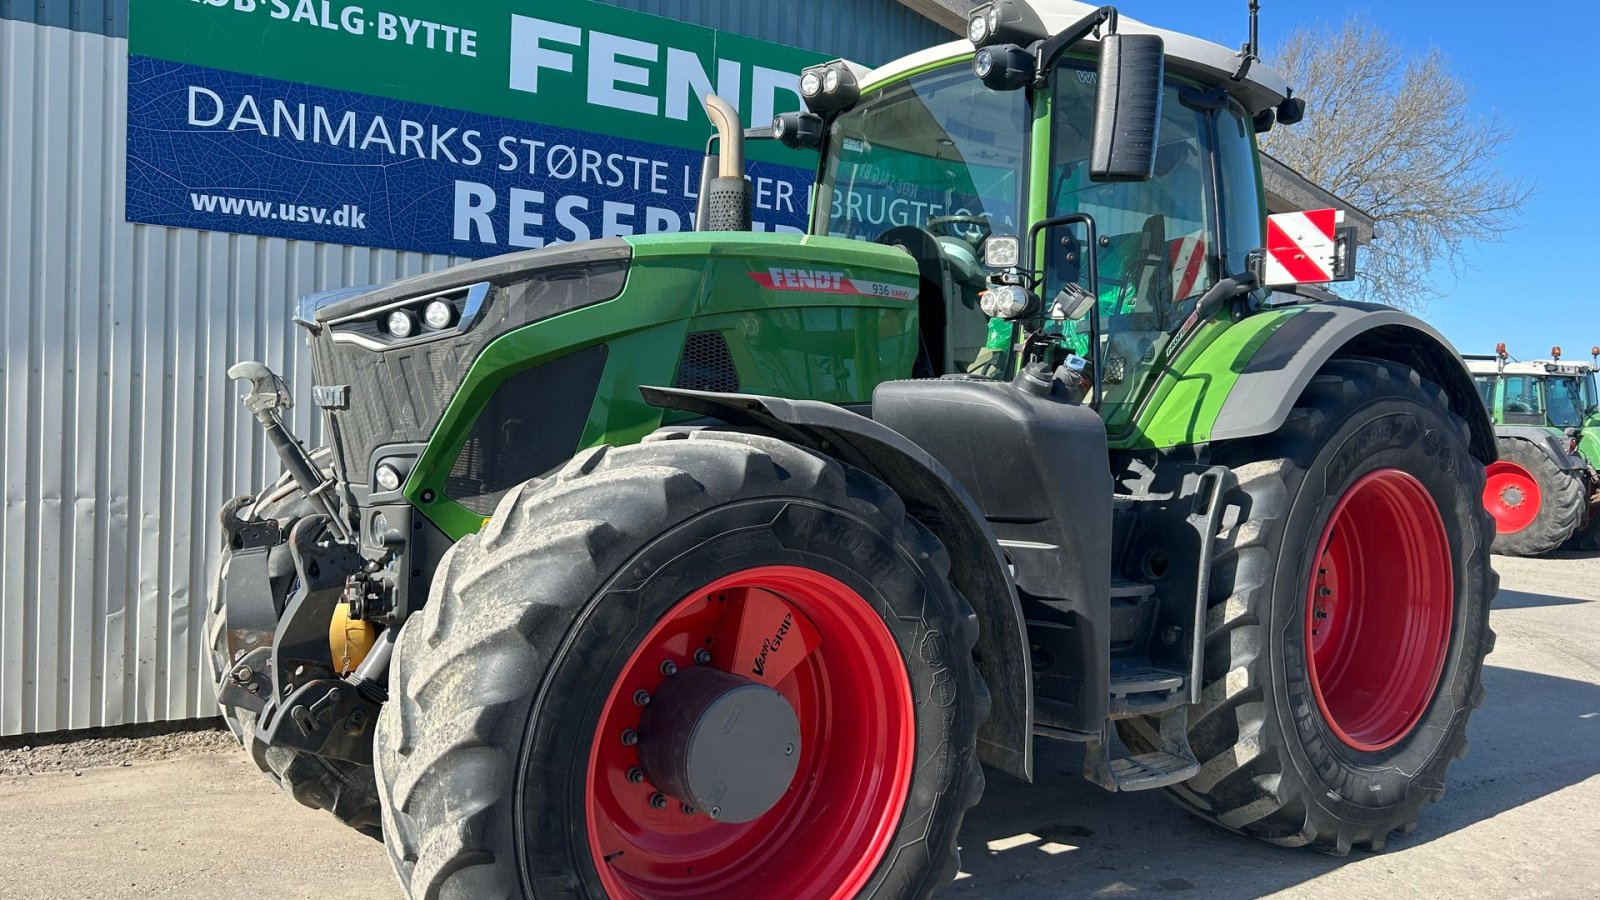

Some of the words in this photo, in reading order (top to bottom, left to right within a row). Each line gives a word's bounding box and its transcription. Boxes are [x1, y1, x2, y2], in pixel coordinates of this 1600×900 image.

[509, 13, 806, 127] FEND
[188, 85, 482, 166] DANMARKS
[498, 135, 668, 194] STØRSTE
[684, 165, 794, 213] LER
[190, 192, 366, 229] www.usv.dk
[768, 267, 844, 290] FENDT
[872, 283, 890, 296] 936
[770, 612, 792, 652] GRIP
[752, 637, 771, 677] VARIO
